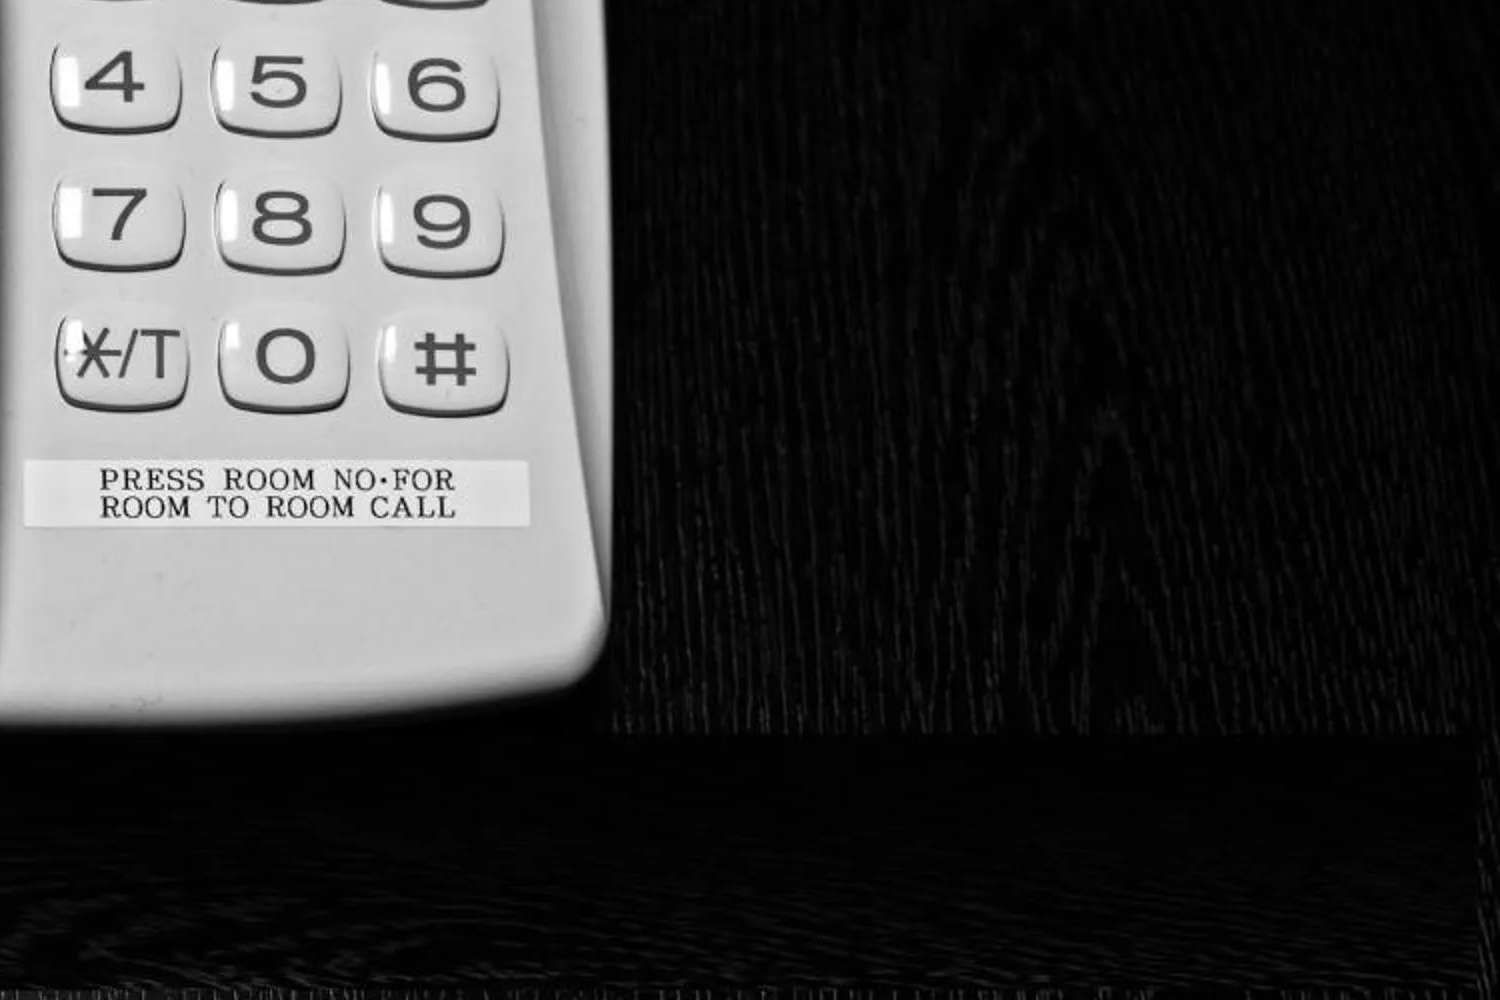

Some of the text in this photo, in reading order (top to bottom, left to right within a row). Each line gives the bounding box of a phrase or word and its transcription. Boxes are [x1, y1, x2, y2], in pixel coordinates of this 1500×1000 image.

[83, 50, 145, 103] 4
[250, 55, 307, 109] 5
[407, 57, 467, 113] 6
[91, 187, 148, 241] 7
[251, 190, 313, 247] 8
[413, 194, 471, 250] 9
[100, 467, 205, 492] PRESS
[224, 468, 315, 491] ROOM
[100, 495, 456, 519] ROOM TO ROOM CALL
